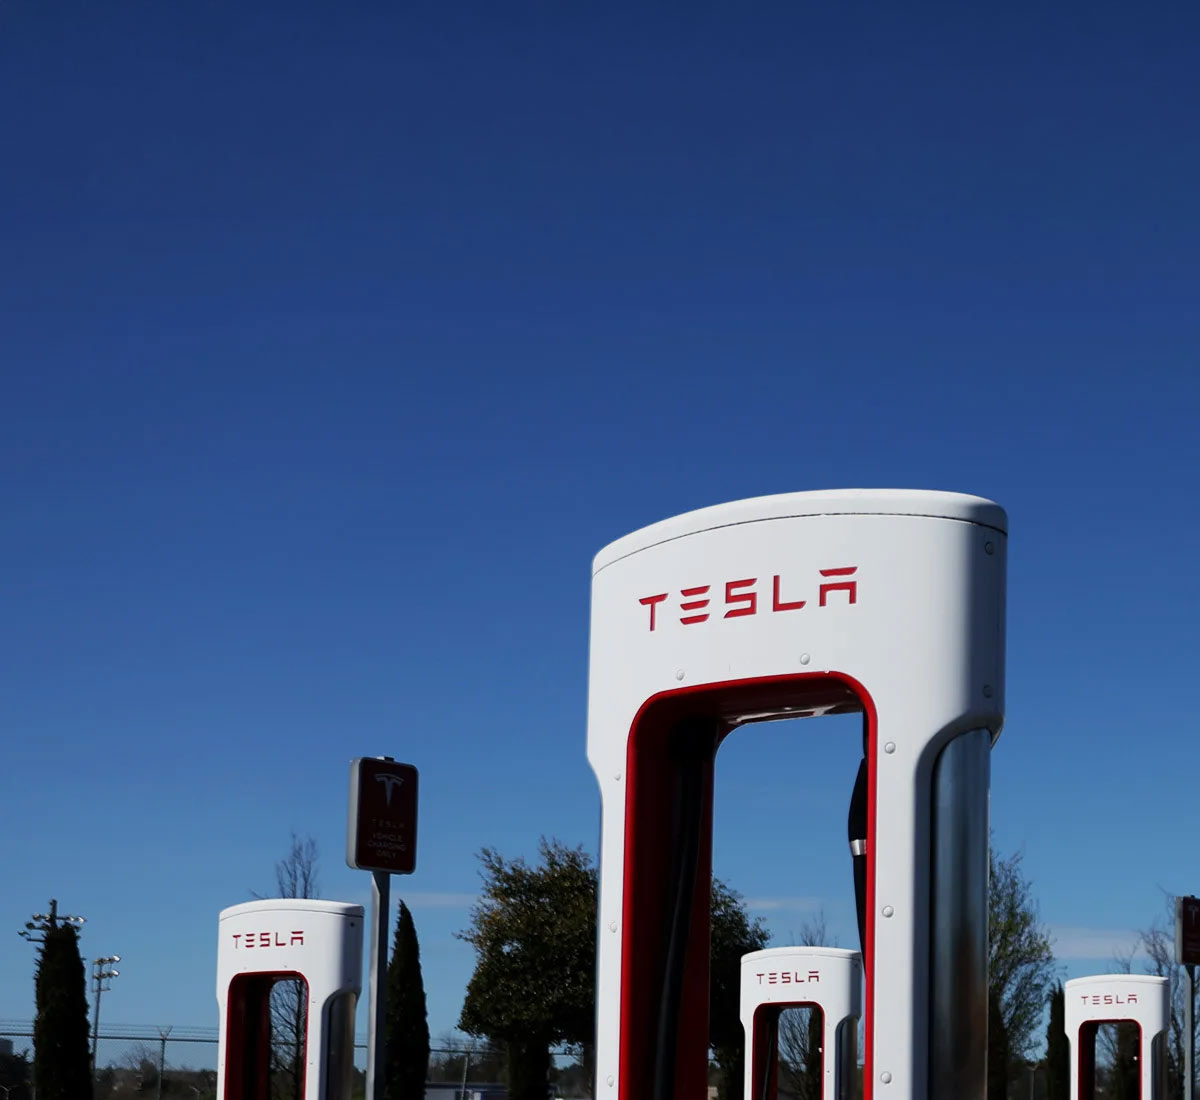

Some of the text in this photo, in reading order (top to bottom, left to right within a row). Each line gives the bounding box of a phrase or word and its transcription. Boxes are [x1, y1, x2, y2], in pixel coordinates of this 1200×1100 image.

[640, 568, 856, 630] TESLA
[233, 931, 305, 949] TESLA
[756, 970, 820, 985] TESLA
[1081, 994, 1139, 1006] TESLA
